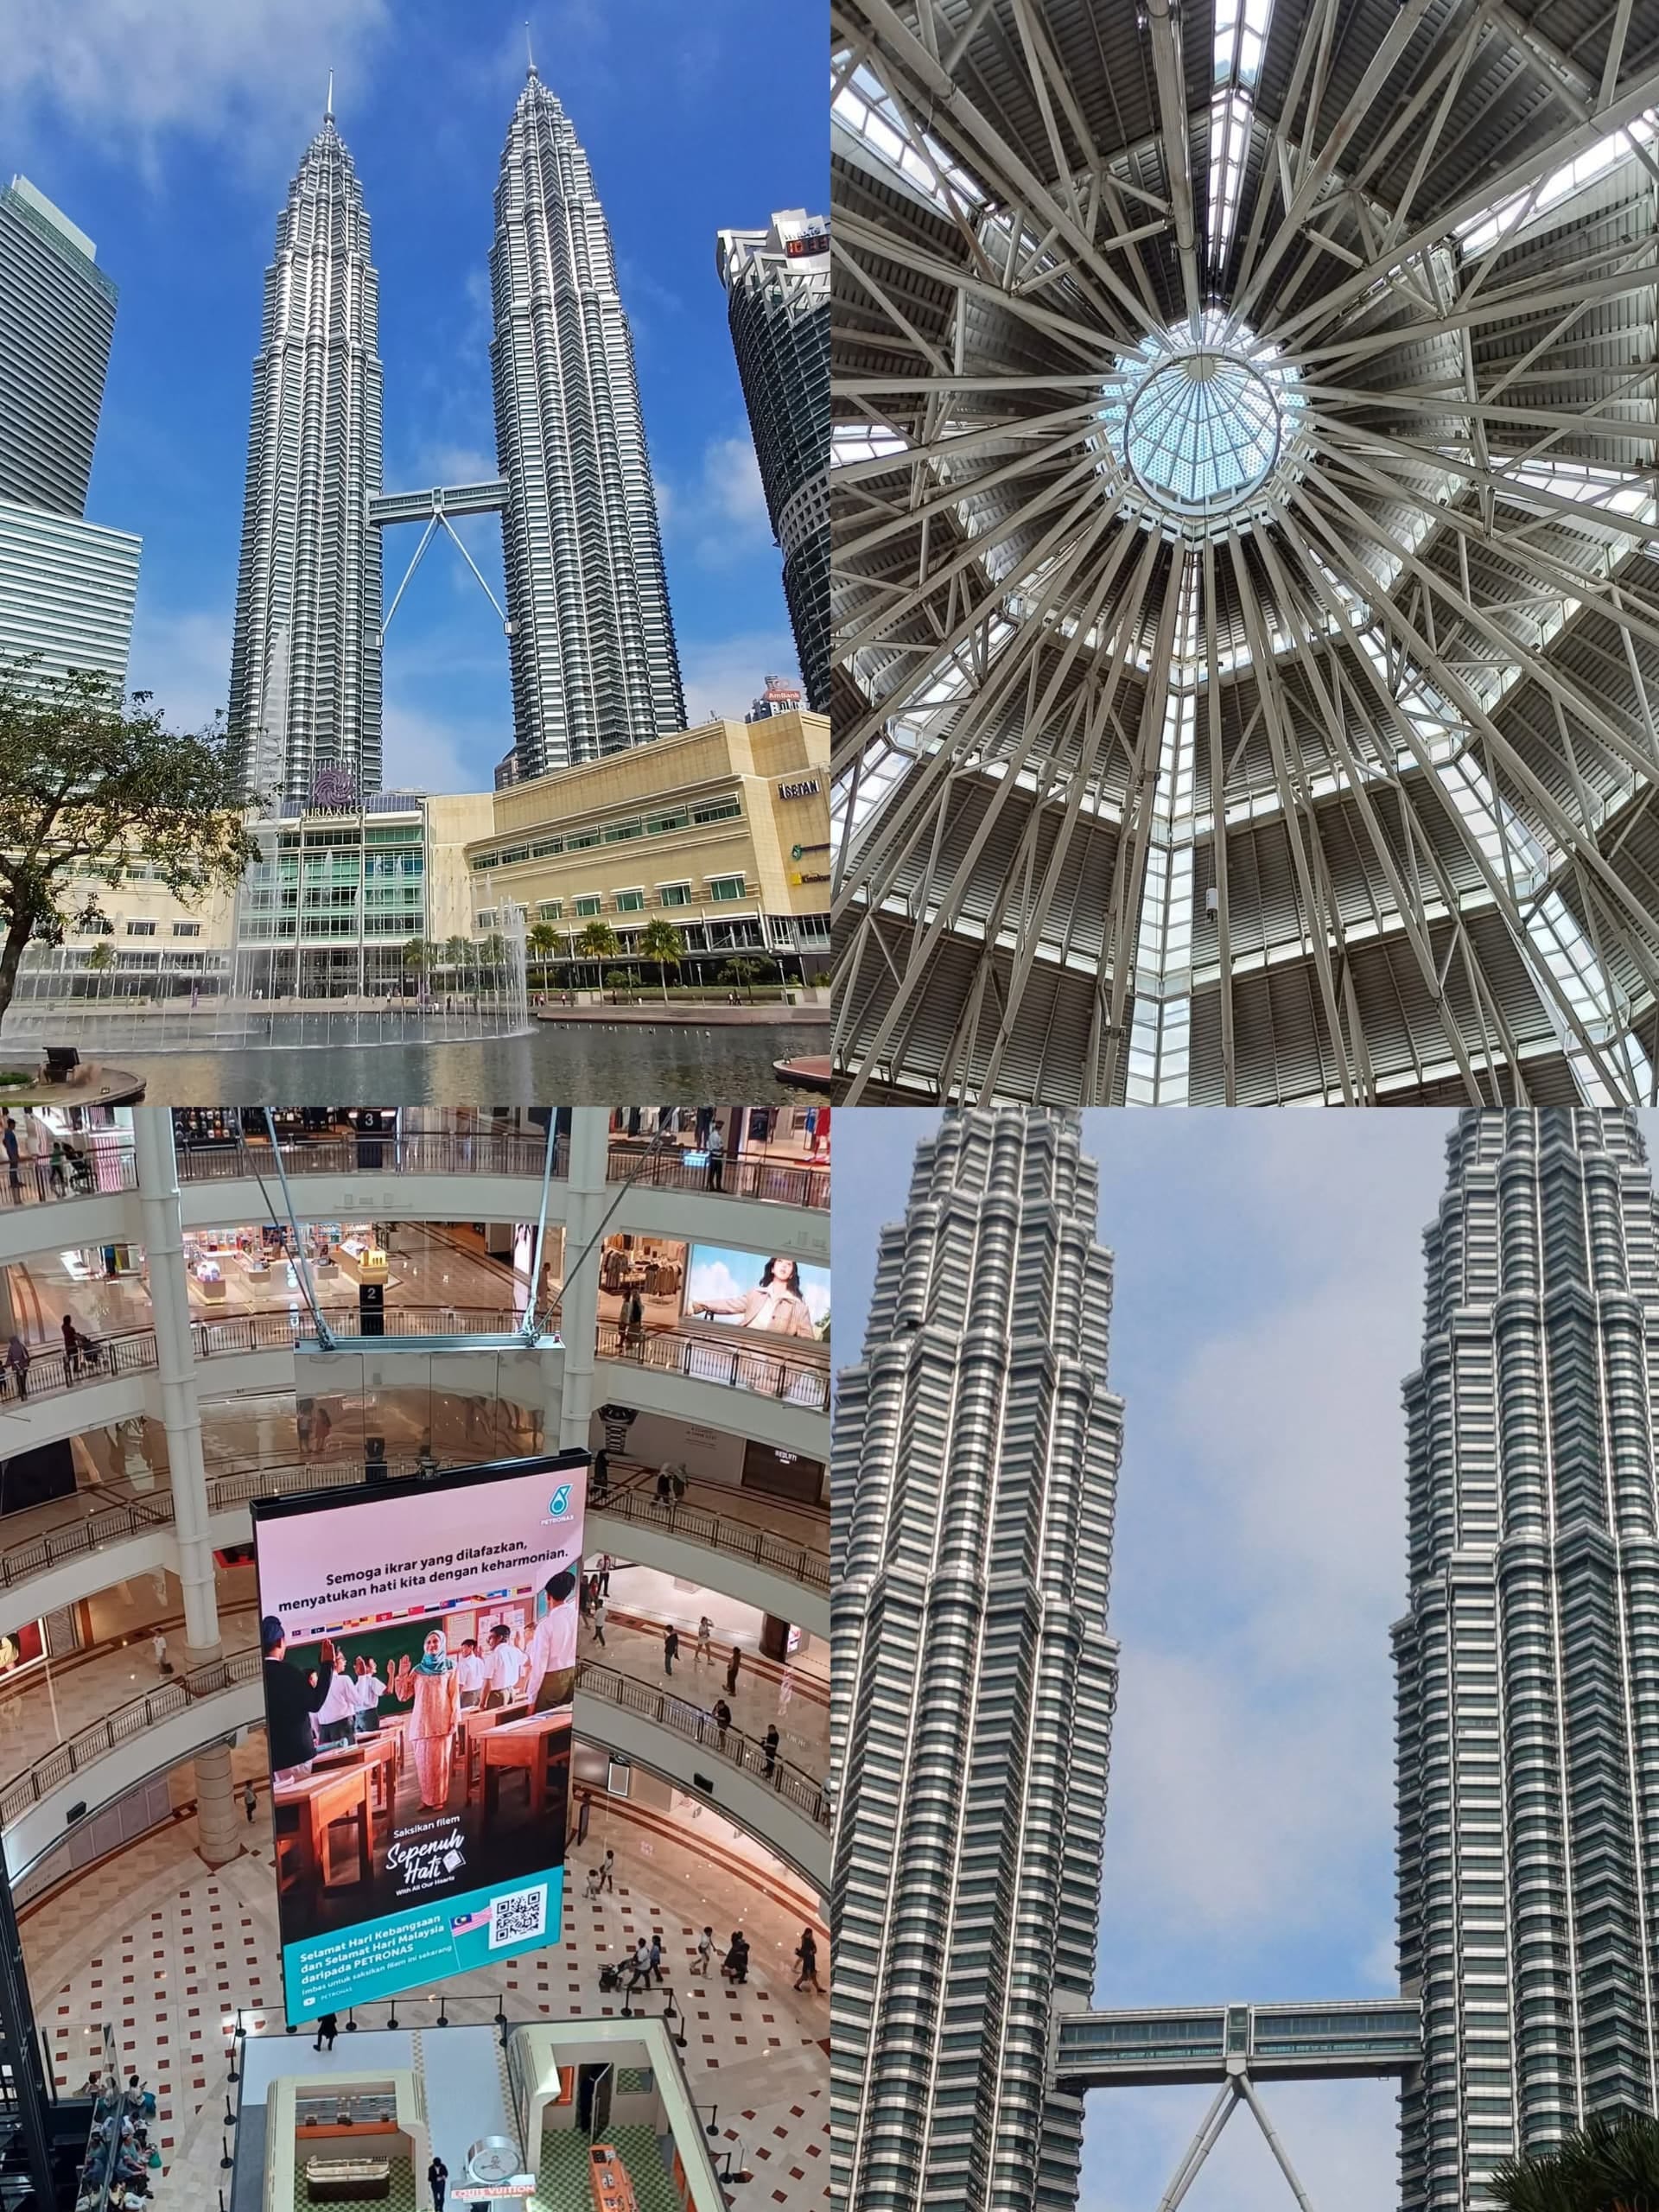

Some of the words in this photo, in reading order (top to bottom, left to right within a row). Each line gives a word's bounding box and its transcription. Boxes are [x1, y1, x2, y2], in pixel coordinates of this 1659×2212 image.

[778, 779, 820, 801] ISETAN
[365, 1112, 374, 1127] 3
[366, 1287, 377, 1300] 2
[540, 1514, 575, 1526] PETRONAS
[326, 1567, 382, 1586] Semoga
[385, 1560, 418, 1575] ikrar
[421, 1554, 453, 1571] yang
[456, 1541, 528, 1561] dilafazkan,
[278, 1586, 367, 1611] menyatukan
[370, 1580, 397, 1594] hati
[400, 1574, 426, 1588] kita
[429, 1566, 478, 1583] dengan
[481, 1548, 569, 1573] keharmonian.
[393, 1821, 435, 1839] Saksikan
[436, 1815, 461, 1827] filem
[385, 1827, 465, 1870] Sepenuh
[404, 1854, 442, 1884] Hati
[396, 1886, 412, 1896] With
[435, 1875, 455, 1885] Hearts
[300, 1943, 346, 1962] Selamat
[348, 1934, 372, 1948] Hari
[375, 1915, 441, 1940] Kebangsaan
[301, 1959, 323, 1974] dan
[325, 1944, 370, 1967] Selamat
[372, 1937, 396, 1951] Hari
[398, 1924, 445, 1945] Malaysia
[301, 1964, 352, 1986] daripada
[353, 1943, 414, 1968] PETRONAS
[302, 1984, 327, 1996] Imbas
[327, 1975, 351, 1988] untuk
[353, 1966, 385, 1980] saksikan
[386, 1960, 406, 1970] filem
[418, 1945, 453, 1961] sekarang
[321, 1986, 353, 2001] PETRONAS
[488, 2184, 535, 2196] VUITTON
